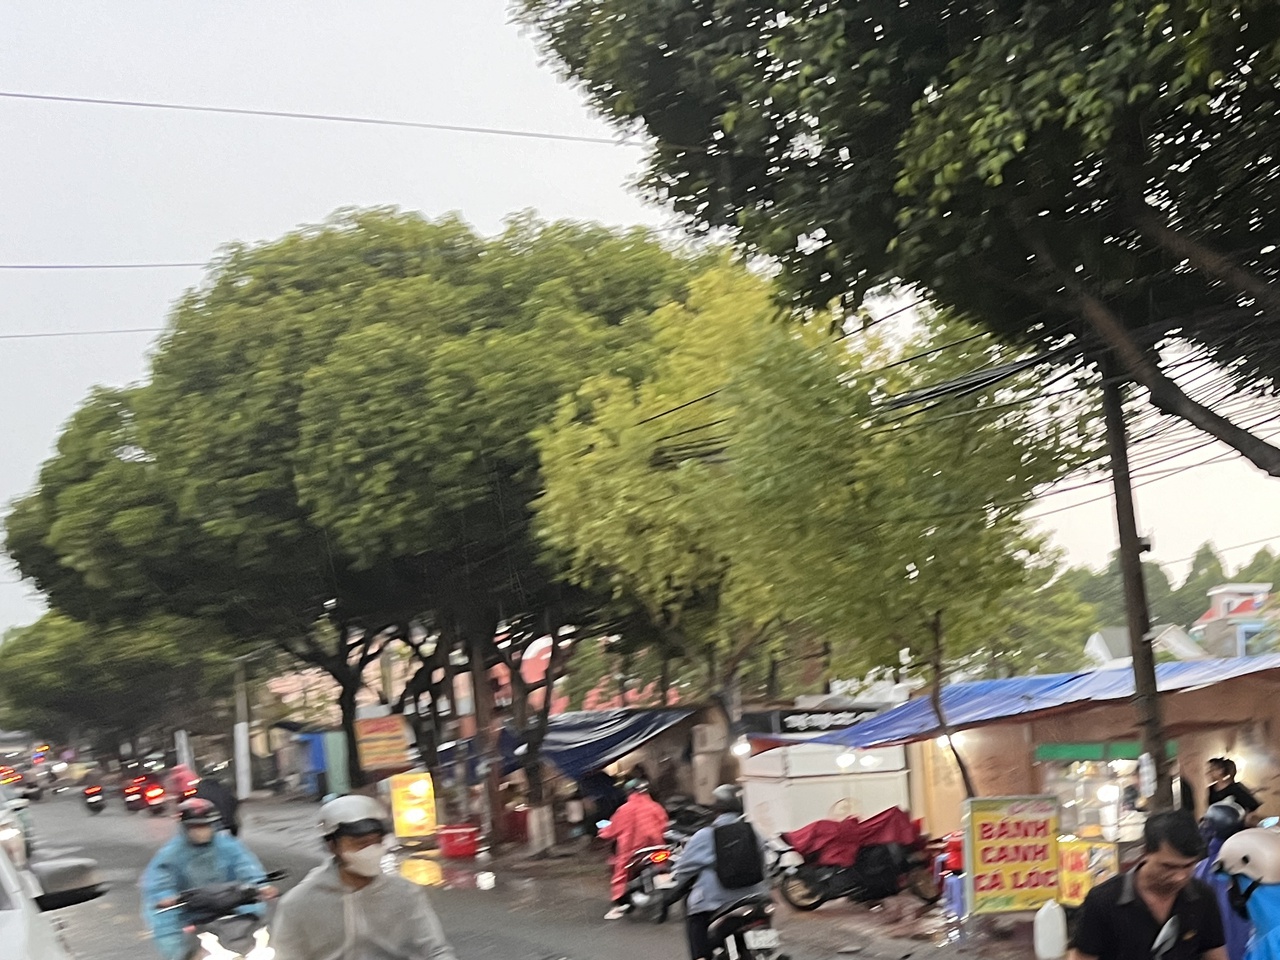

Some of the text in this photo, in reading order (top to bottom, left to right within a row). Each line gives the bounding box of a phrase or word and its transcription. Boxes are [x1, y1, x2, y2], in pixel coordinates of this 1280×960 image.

[979, 817, 1049, 839] BÁNH
[981, 844, 1049, 864] CANH
[974, 867, 1058, 892] CÁ LÓC
